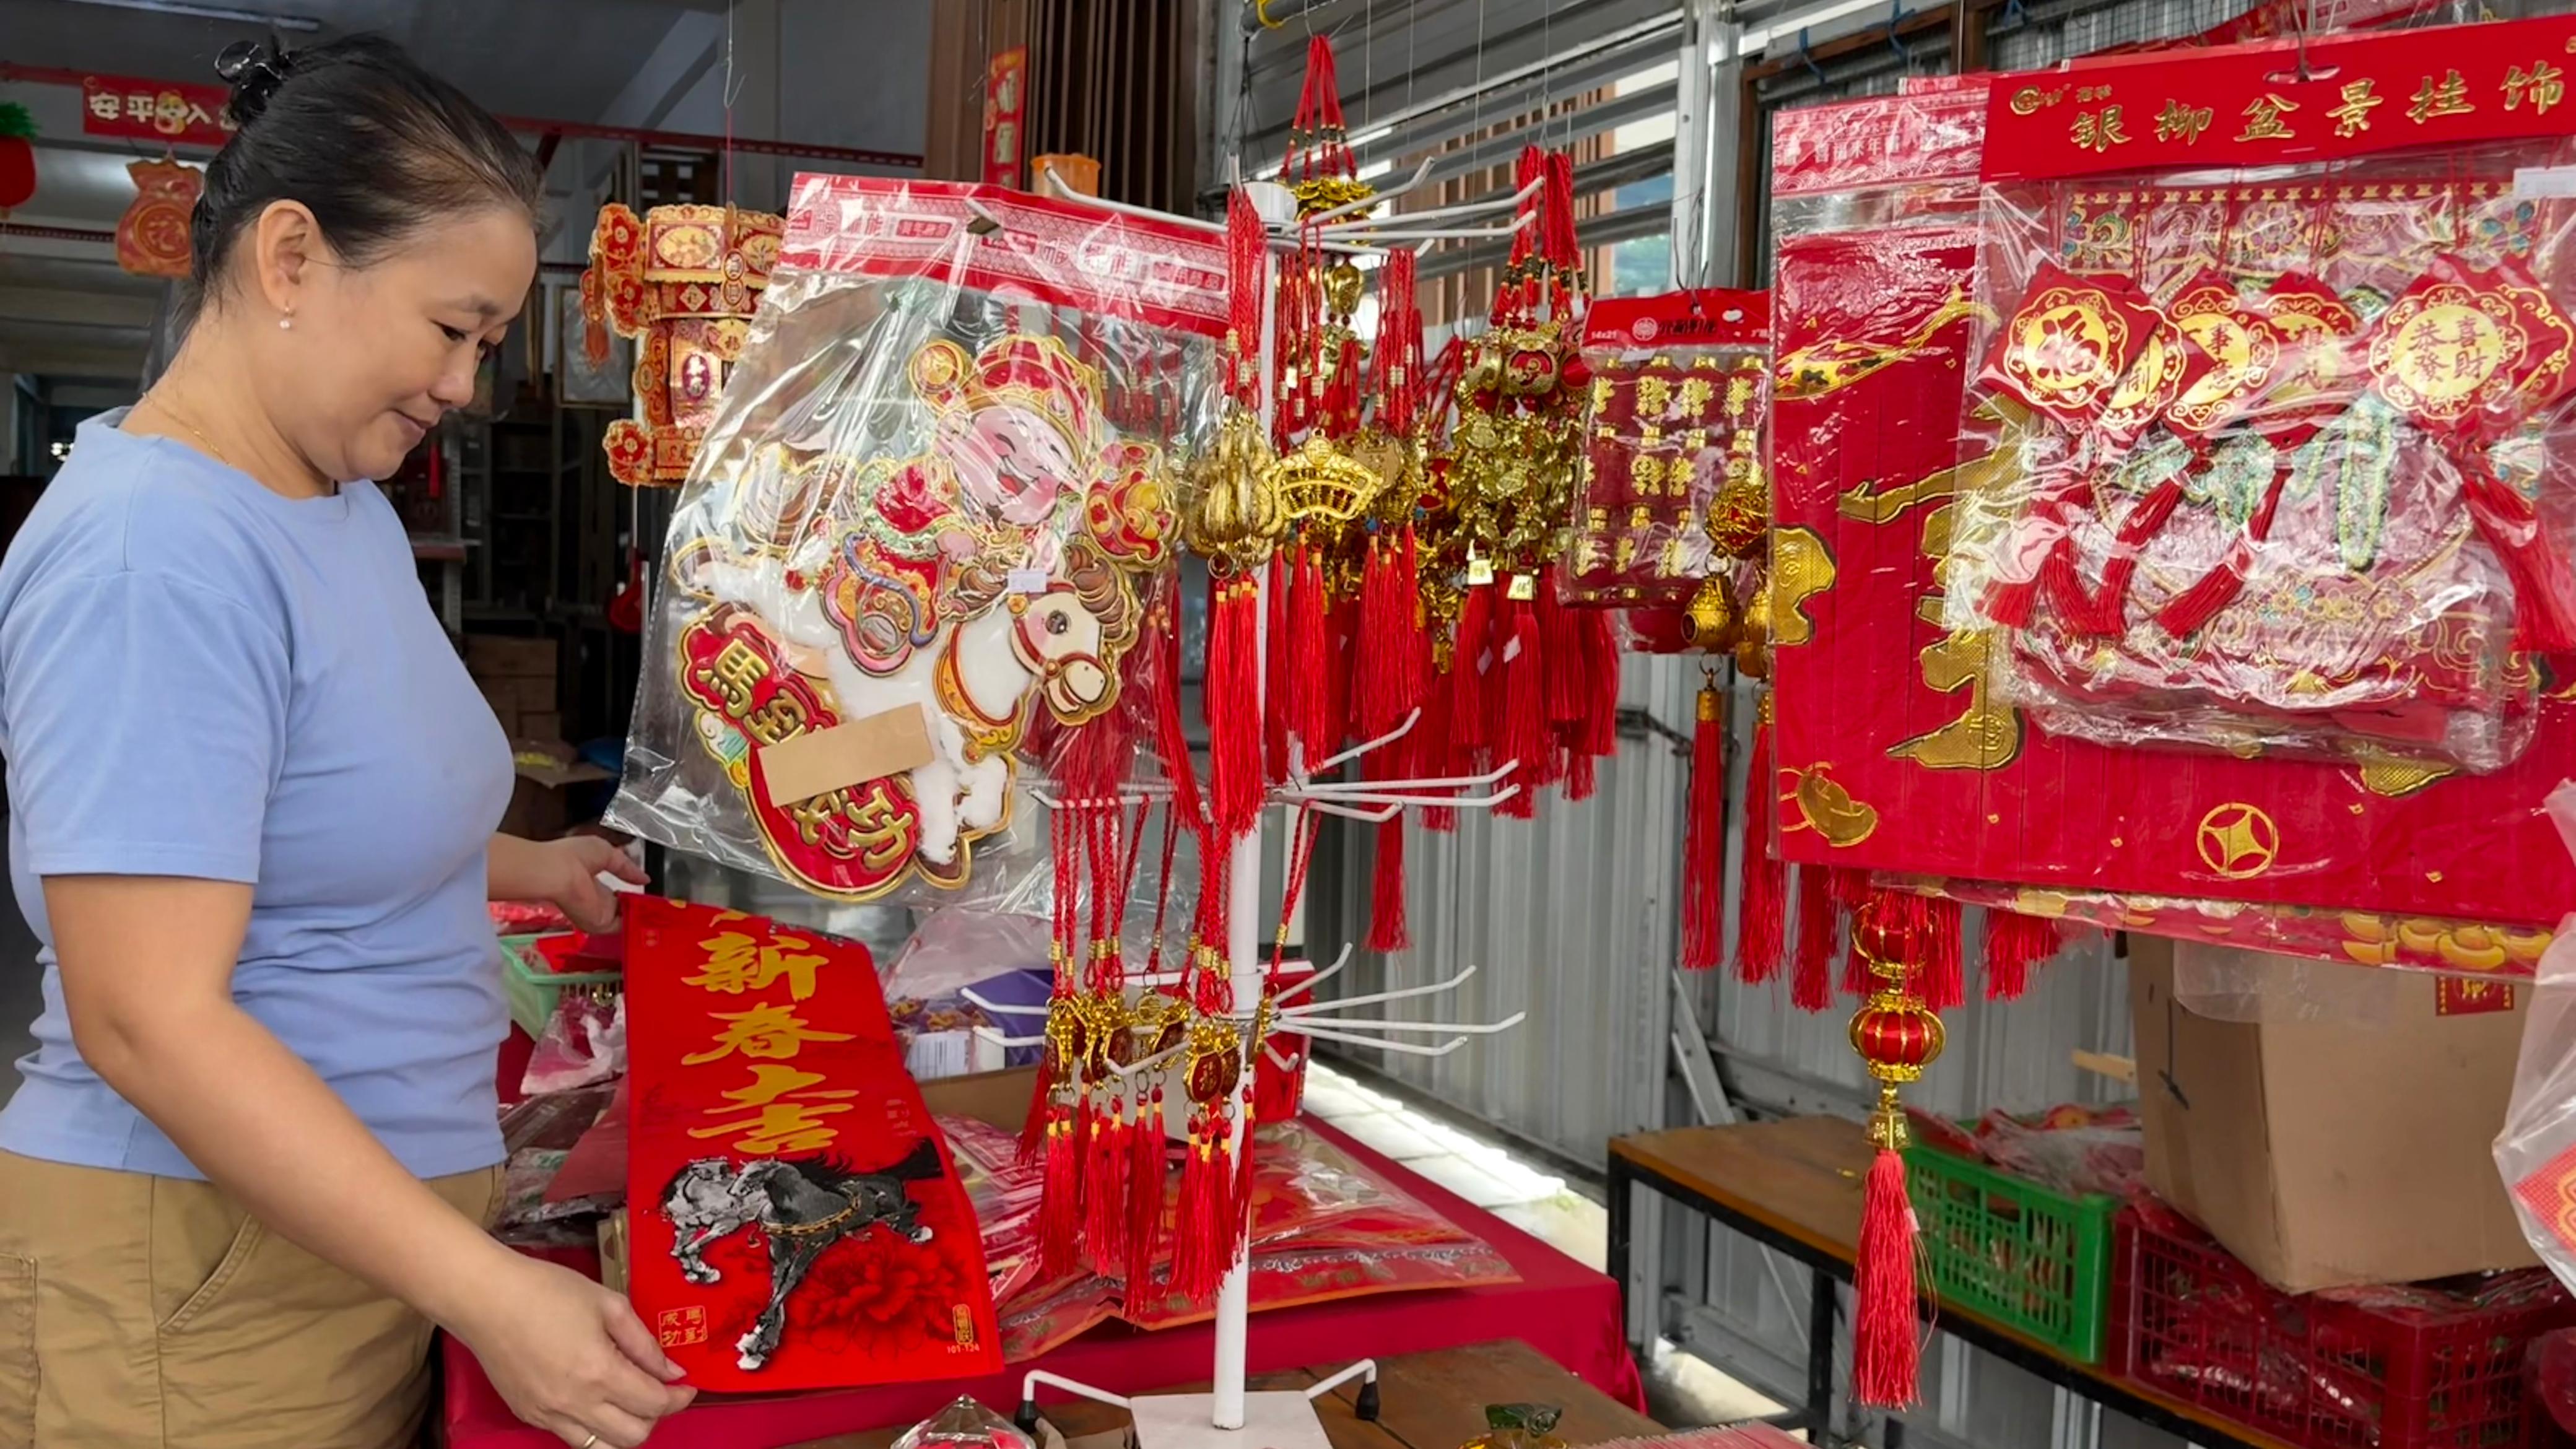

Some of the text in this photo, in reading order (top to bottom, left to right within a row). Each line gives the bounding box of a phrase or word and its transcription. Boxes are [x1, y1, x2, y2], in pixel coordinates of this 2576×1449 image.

[2034, 309, 2102, 381] 福
[2408, 316, 2486, 351] 恭喜
[681, 931, 860, 1154] 新春大吉
